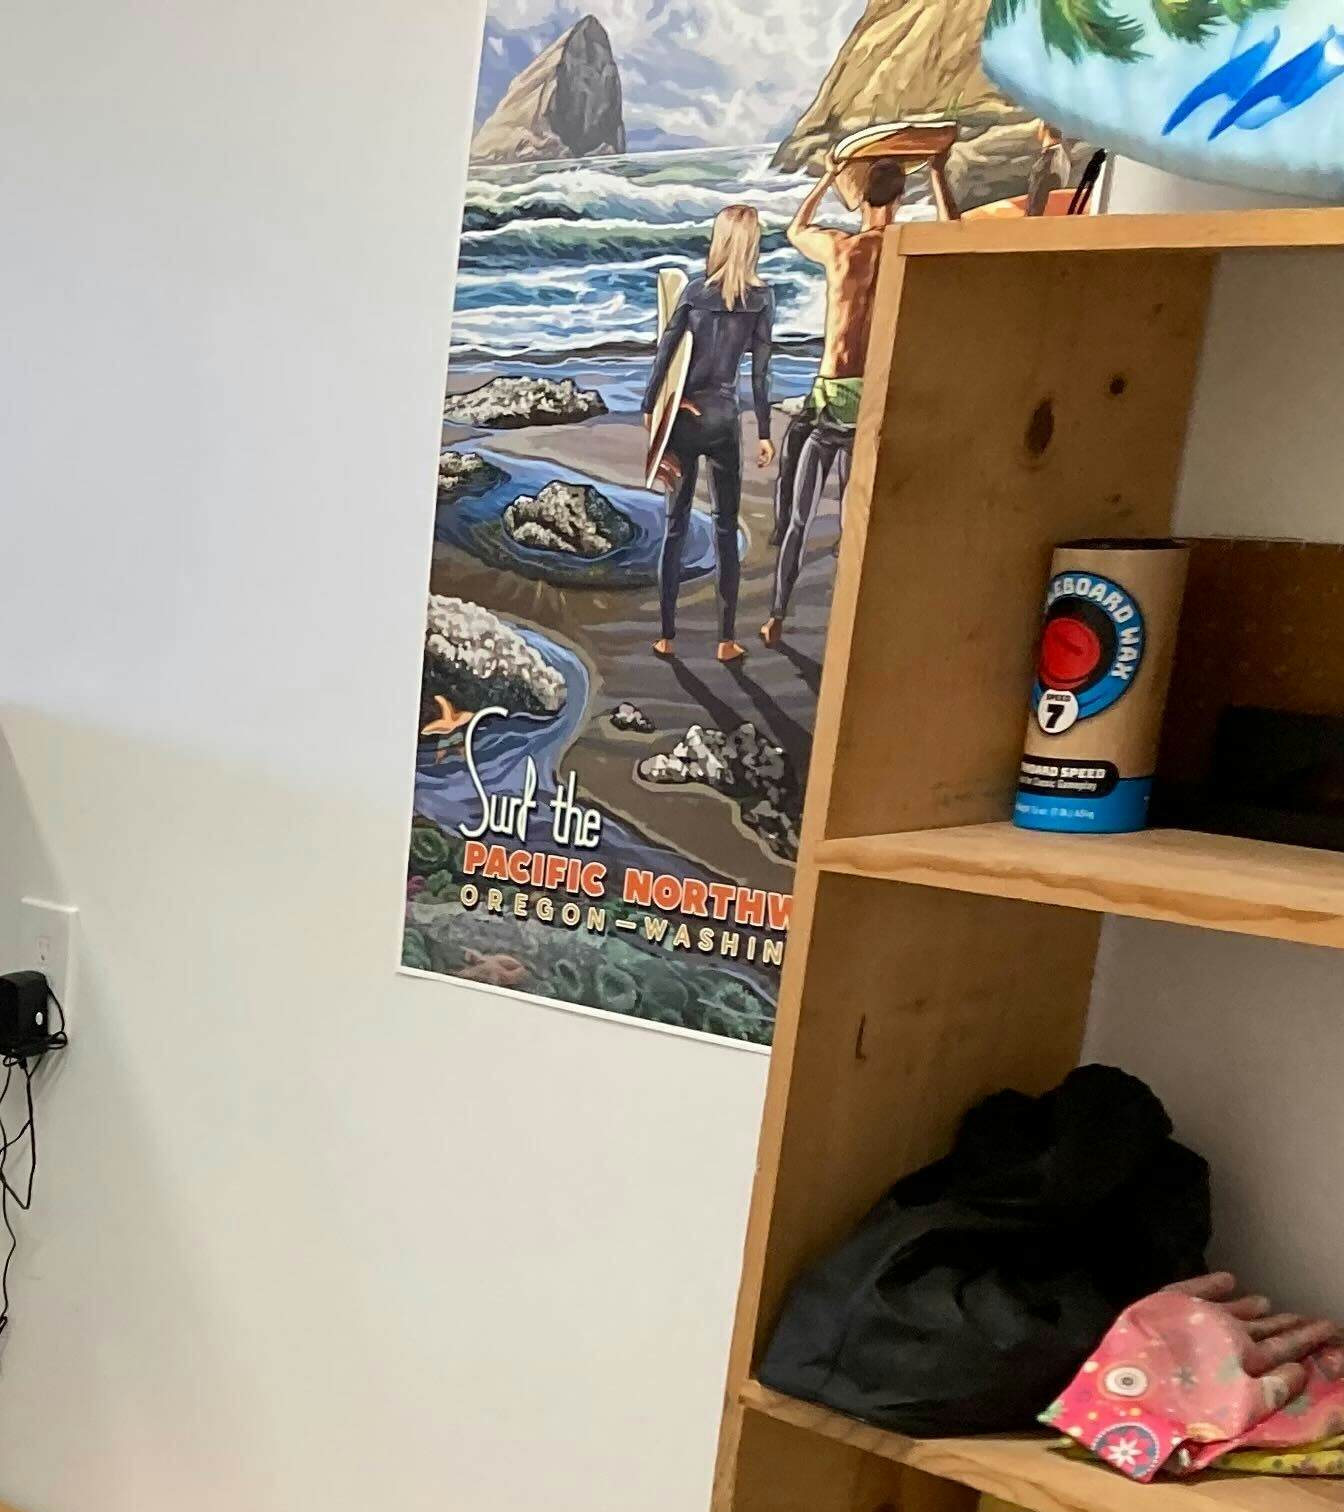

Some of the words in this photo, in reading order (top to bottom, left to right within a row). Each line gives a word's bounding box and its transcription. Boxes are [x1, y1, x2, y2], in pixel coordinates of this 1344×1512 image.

[1111, 626, 1140, 680] WAX
[1045, 703, 1065, 729] 7
[458, 706, 537, 843] Surf
[550, 770, 602, 850] the
[462, 840, 607, 898] PACIFIC
[459, 883, 606, 933] OREGON
[643, 914, 784, 967] WASHIN
